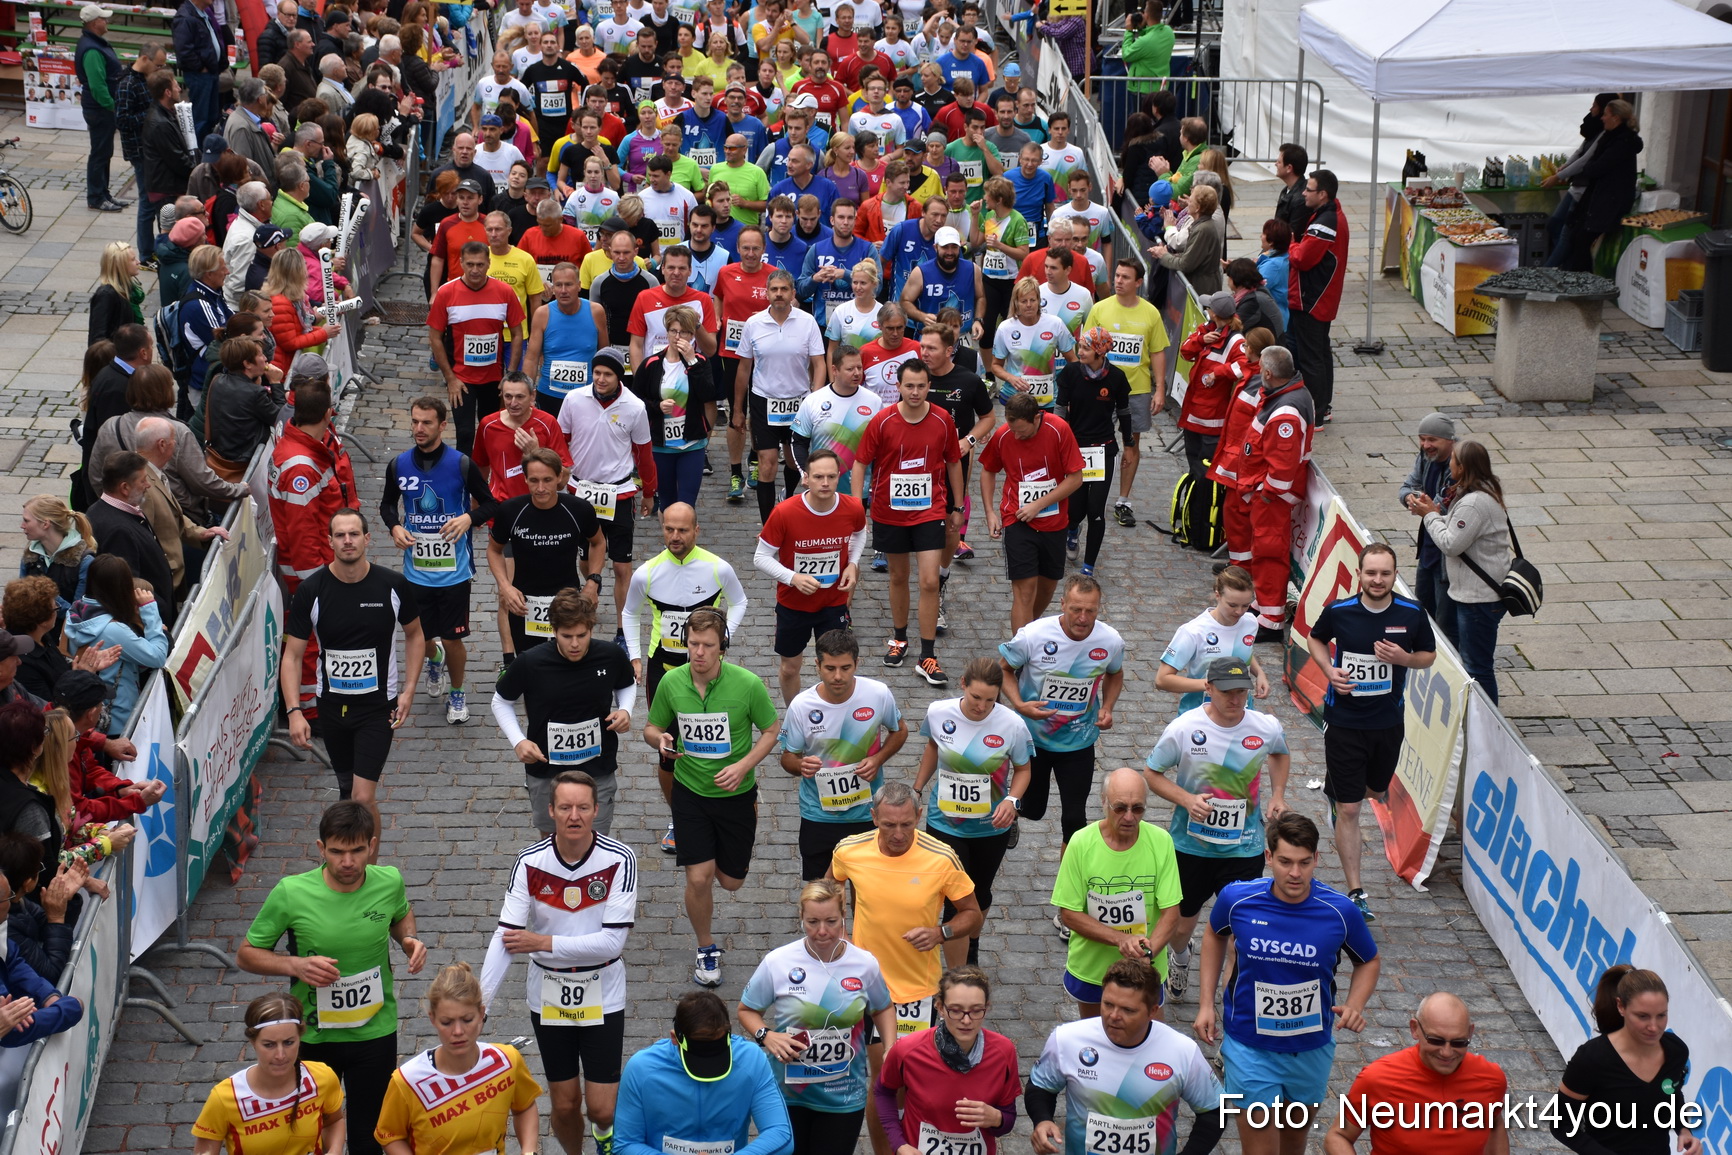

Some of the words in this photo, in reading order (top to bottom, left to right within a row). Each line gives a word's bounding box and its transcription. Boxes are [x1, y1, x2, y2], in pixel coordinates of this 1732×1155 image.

[674, 11, 693, 24] 2417
[905, 22, 919, 32] 240
[543, 99, 564, 114] 2497
[684, 124, 700, 136] 14
[691, 153, 715, 166] 2030
[904, 241, 916, 252] 5
[817, 255, 834, 266] 12
[984, 259, 1004, 272] 2475
[323, 266, 335, 290] BMW
[822, 290, 857, 300] FIBALO
[925, 284, 943, 297] 13
[728, 327, 743, 340] 25
[468, 342, 496, 355] 2095
[1112, 340, 1140, 355] 2036
[553, 369, 584, 383] 2289
[771, 400, 799, 414] 2046
[399, 475, 419, 490] 22
[894, 483, 928, 497] 2361
[584, 489, 609, 506] 210
[900, 498, 923, 507] Thomas
[513, 526, 530, 537] Vegan
[521, 533, 547, 544] Laufen
[548, 532, 572, 544] gegen
[533, 539, 560, 547] Leiden
[794, 537, 843, 548] NEUMARKT
[416, 542, 452, 558] 5162
[799, 560, 837, 575] 2277
[533, 606, 550, 621] 22
[535, 624, 553, 633] Andre
[671, 640, 685, 649] Tho
[1089, 650, 1107, 660] Hervis
[331, 660, 373, 678] 2222
[1347, 663, 1388, 681] 2510
[341, 682, 364, 691] Martin
[1355, 683, 1383, 692] ebastian
[1046, 685, 1089, 702] 2729
[1054, 703, 1074, 712] Ulrich
[677, 715, 696, 724] PARTL
[855, 710, 874, 722] Hervis
[548, 726, 567, 734] PARTL
[567, 723, 593, 733] Neumarkt
[682, 723, 726, 742] 2482
[553, 730, 597, 750] 2481
[985, 735, 1004, 747] Hervis
[1244, 737, 1263, 749] Hervis
[693, 743, 718, 753] Sascha
[559, 750, 593, 761] Benjamin
[815, 772, 834, 780] PARTL
[940, 775, 956, 783] PARTL
[827, 776, 861, 796] 104
[949, 784, 981, 802] 105
[831, 795, 861, 807] Matthias
[955, 804, 973, 814] Nora
[1205, 809, 1241, 829] 081
[1199, 827, 1230, 839] Andreas
[1087, 894, 1105, 905] PARTL
[1105, 896, 1134, 905] Neumarkt
[1097, 904, 1135, 925] 296
[1249, 937, 1318, 958] SYSCAD
[1246, 953, 1320, 968] www.metallbau-cad.de
[341, 977, 372, 989] Neumarkt
[564, 976, 593, 984] Neumarkt
[331, 985, 372, 1010] 502
[560, 985, 586, 1007] 89
[1256, 986, 1279, 996] PARTL
[1279, 987, 1311, 997] Neumarkt
[1261, 993, 1315, 1017] 2387
[558, 1009, 586, 1020] Harald
[1274, 1019, 1304, 1030] Fabian
[816, 1035, 842, 1045] eumarkt
[1077, 1068, 1099, 1077] PARTL
[1147, 1065, 1171, 1082] Hervis
[428, 1099, 471, 1129] MAX
[472, 1075, 515, 1107] BÖGL
[243, 1116, 281, 1137] MAX
[1088, 1118, 1112, 1130] PARTL
[1112, 1122, 1146, 1133] Neumarkt
[943, 1133, 978, 1143] Neumarkt
[1092, 1129, 1151, 1155] 2345
[664, 1140, 690, 1153] PARTL
